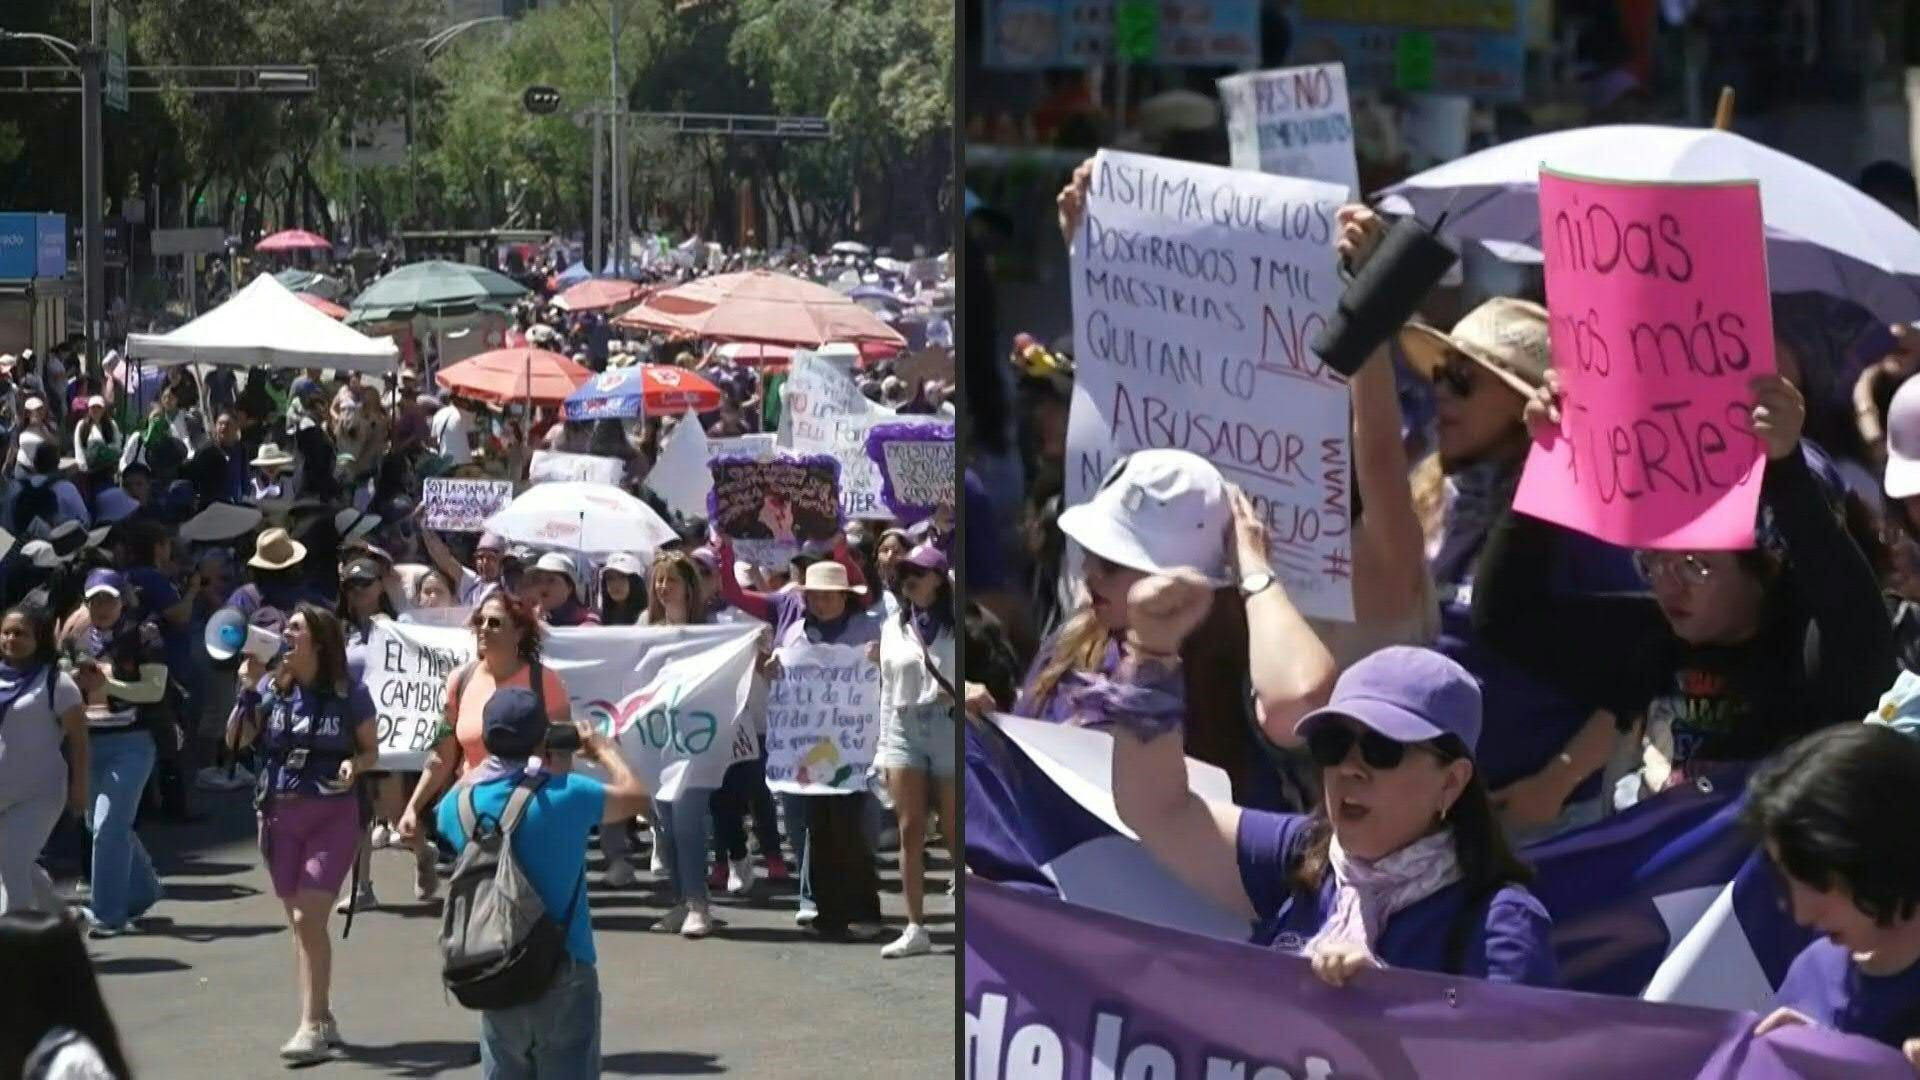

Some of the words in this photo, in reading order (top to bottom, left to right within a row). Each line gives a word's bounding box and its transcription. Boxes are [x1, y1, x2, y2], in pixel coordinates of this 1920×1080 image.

[1211, 184, 1264, 235] QUE
[1281, 201, 1330, 246] LOS
[1086, 214, 1237, 286] POSGRADOS
[1251, 256, 1262, 293] Y
[1270, 260, 1316, 303] MIL
[1086, 310, 1201, 385] QUITAN
[1221, 357, 1256, 402] LO
[1630, 300, 1750, 379] más
[1111, 381, 1314, 486] ABUSADOR
[385, 640, 407, 673] EL
[376, 714, 407, 748] DE
